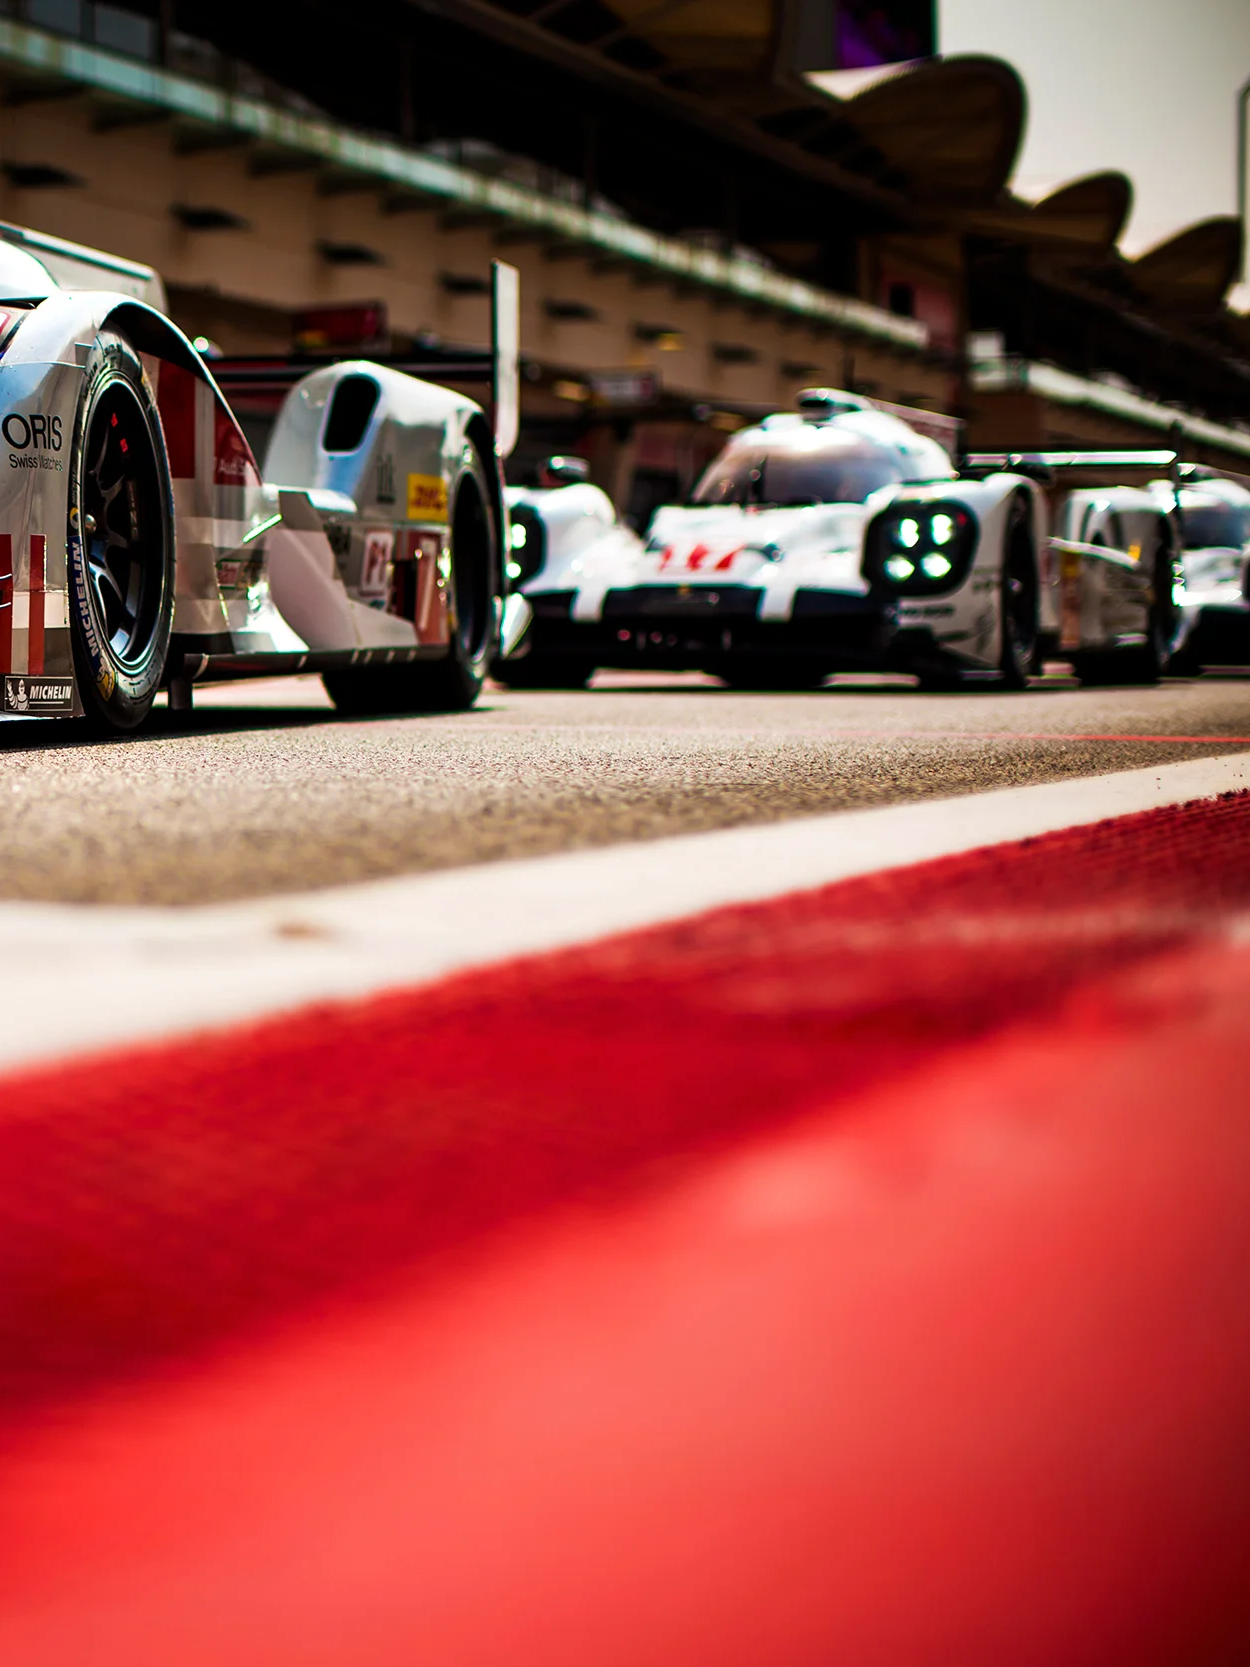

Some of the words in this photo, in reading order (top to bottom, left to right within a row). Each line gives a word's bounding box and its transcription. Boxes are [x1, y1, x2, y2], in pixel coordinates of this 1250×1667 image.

[1, 413, 63, 452] ORIS
[8, 453, 38, 469] Swiss
[72, 541, 101, 658] MICHELIN
[29, 685, 72, 700] MICHELIN
